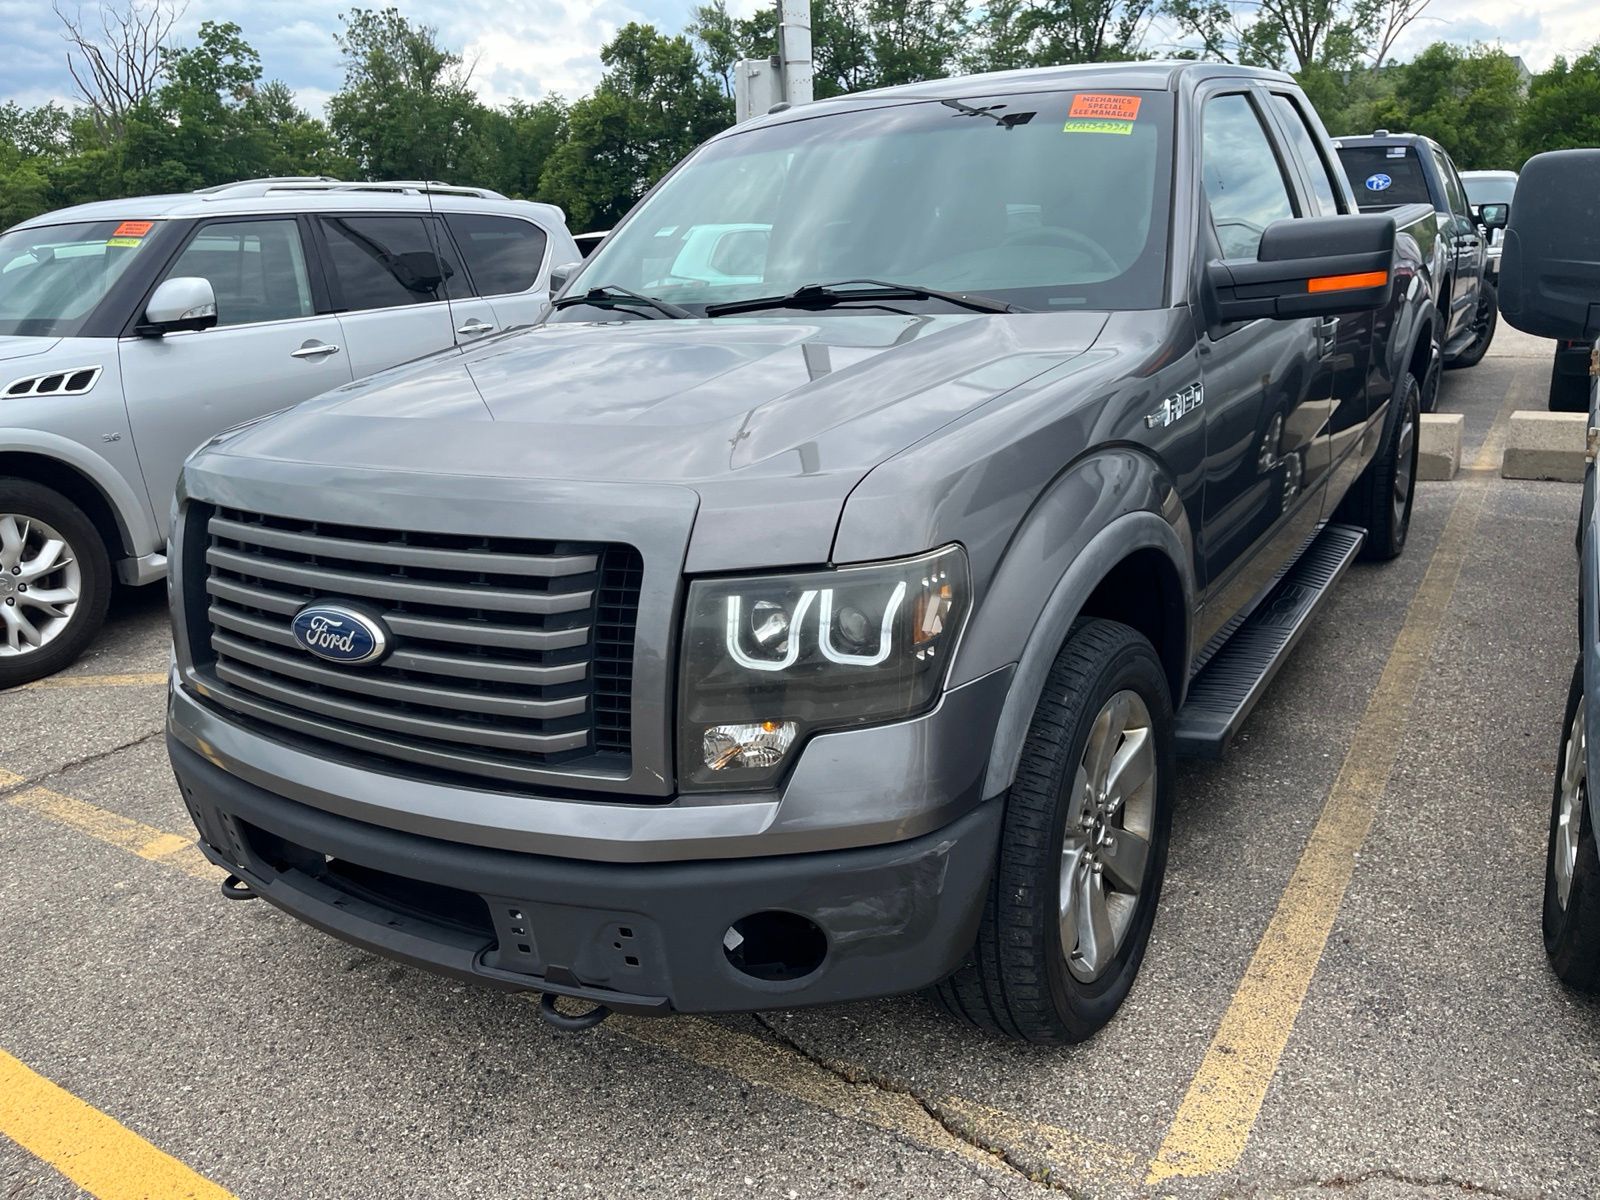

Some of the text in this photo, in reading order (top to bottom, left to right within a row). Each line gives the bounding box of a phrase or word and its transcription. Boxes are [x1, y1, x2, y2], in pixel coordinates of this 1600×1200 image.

[1082, 97, 1132, 105] MECHANICS
[1090, 109, 1134, 118] MANAGER
[306, 616, 356, 653] Ford
